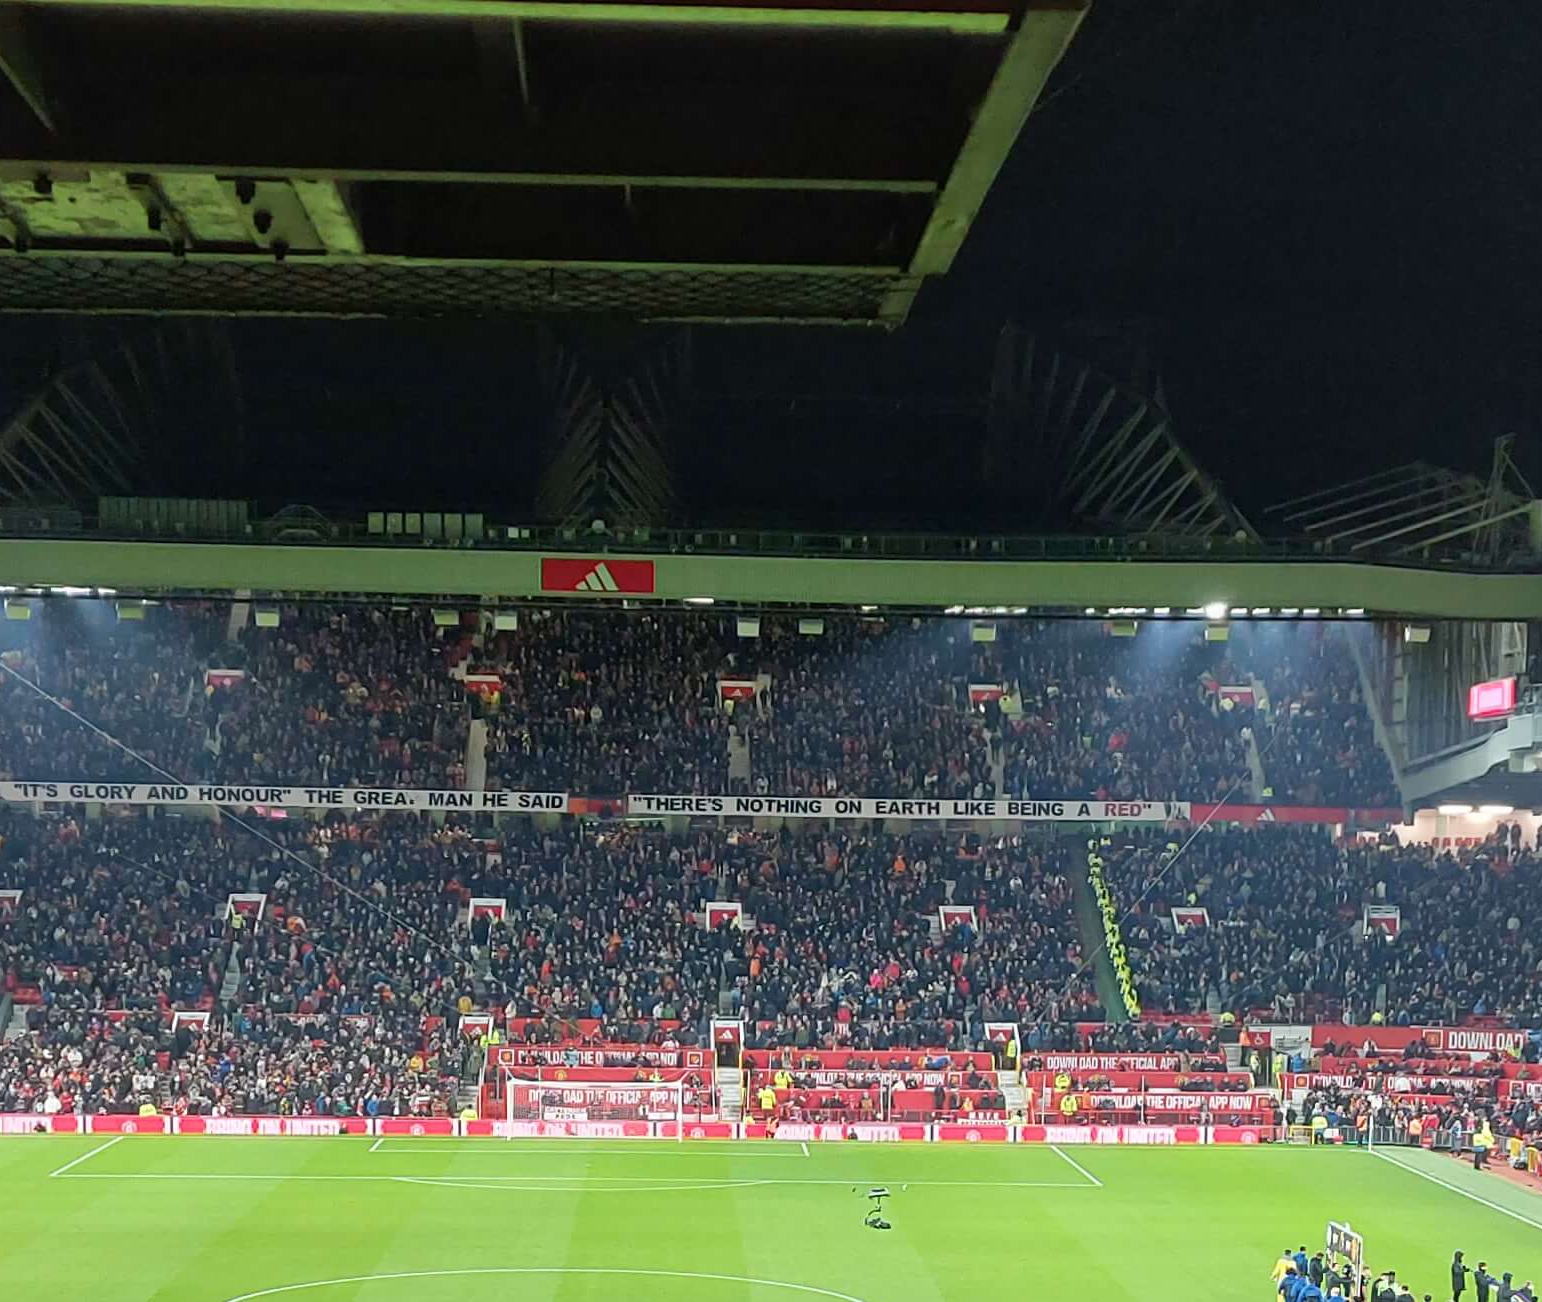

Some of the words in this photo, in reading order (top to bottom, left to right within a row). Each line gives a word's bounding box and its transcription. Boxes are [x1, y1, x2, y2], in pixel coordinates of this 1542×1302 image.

[14, 784, 58, 798] "IT'S
[70, 785, 136, 799] GLORY
[147, 787, 188, 800] AND
[198, 788, 291, 802] HONOUR"
[306, 789, 343, 804] THE
[354, 790, 415, 805] GREA
[428, 792, 473, 806] MAN
[483, 793, 508, 807] HE
[518, 794, 564, 809] SAID
[633, 797, 723, 812] "THERE'S
[736, 798, 822, 814] NOTHING
[835, 799, 861, 814] ON
[875, 800, 940, 815] EARTH
[953, 801, 996, 816] LIKE
[1007, 801, 1064, 817] BEING
[1077, 803, 1091, 817] A
[1104, 803, 1152, 818] RED"
[1448, 1031, 1523, 1051] DOWNLOAD
[1146, 1096, 1164, 1109] THE
[1209, 1097, 1228, 1109] APP
[1229, 1097, 1252, 1110] NOW
